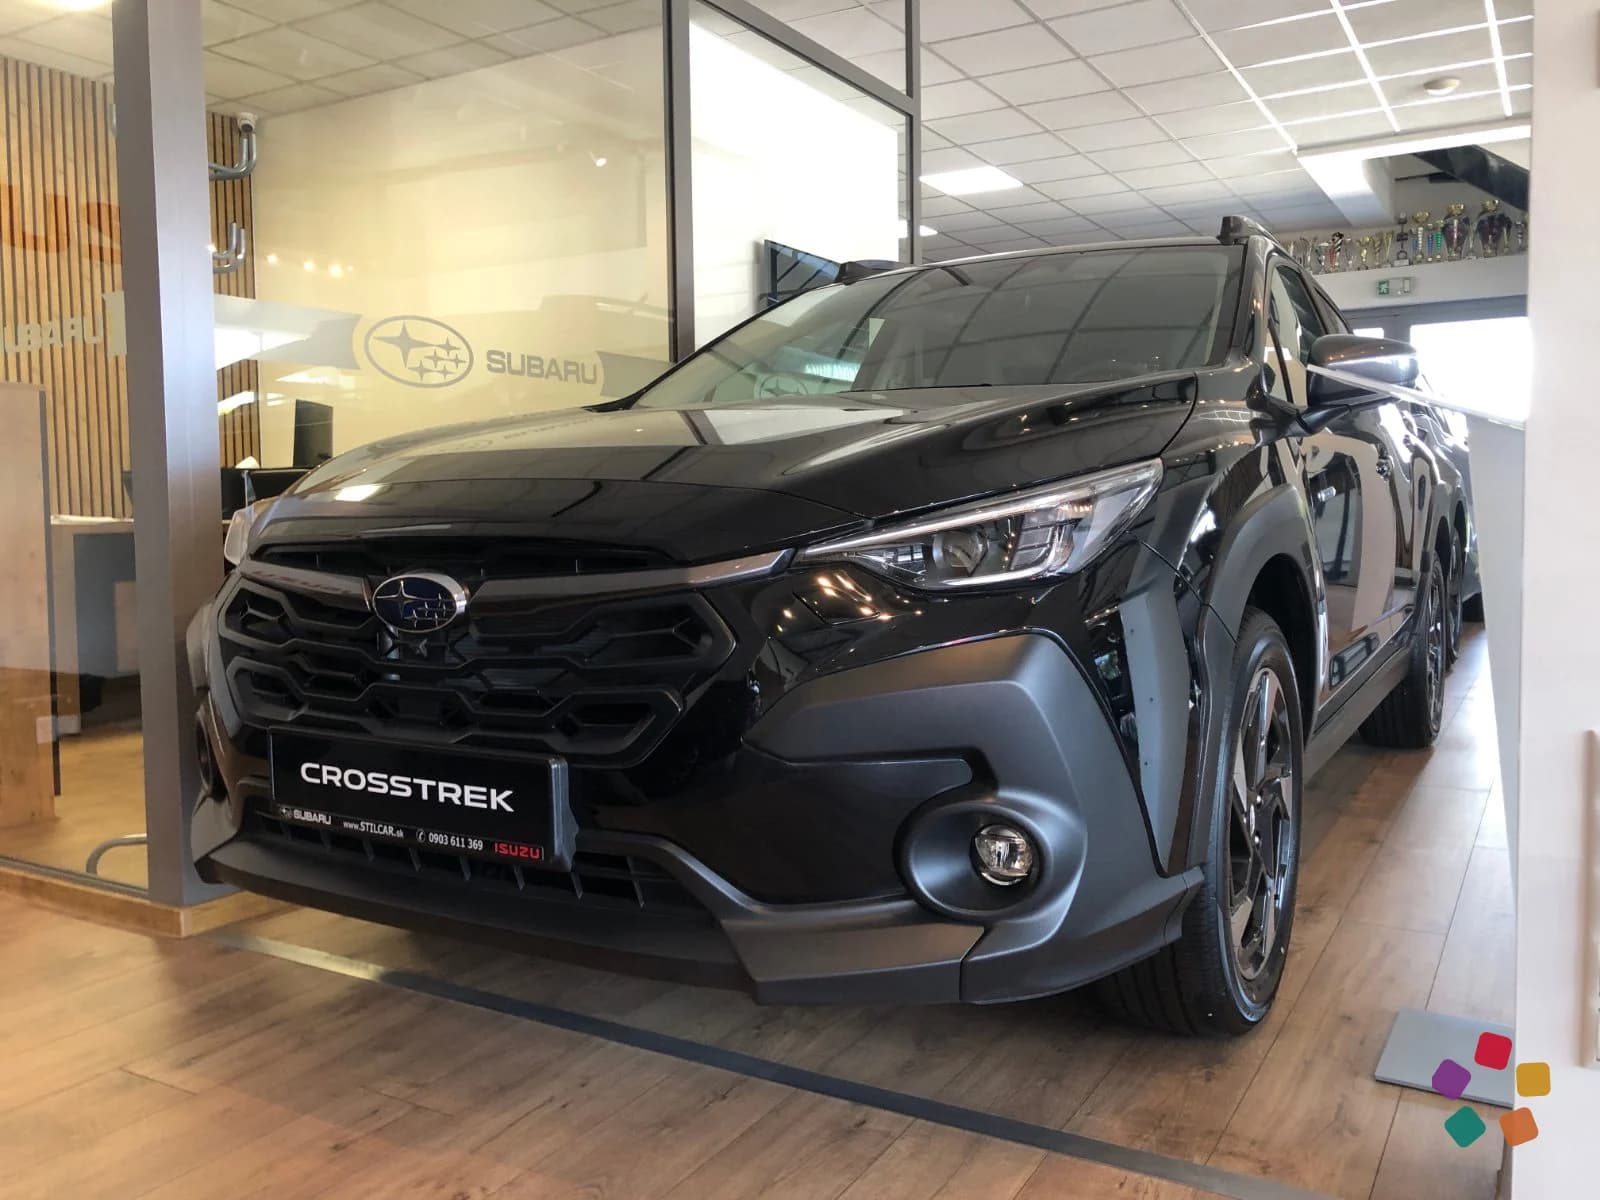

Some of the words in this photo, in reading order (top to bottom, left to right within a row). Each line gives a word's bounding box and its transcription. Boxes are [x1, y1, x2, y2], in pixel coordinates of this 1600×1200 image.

[0, 317, 103, 352] UBARU
[487, 350, 596, 384] SUBARU
[300, 762, 514, 812] CROSSTREK
[293, 809, 331, 825] SUBARU
[343, 821, 404, 838] www.STILCAR.sk
[428, 832, 449, 846] 0903
[450, 836, 465, 848] 611
[467, 839, 484, 851] 369
[494, 842, 540, 860] ISUZU
